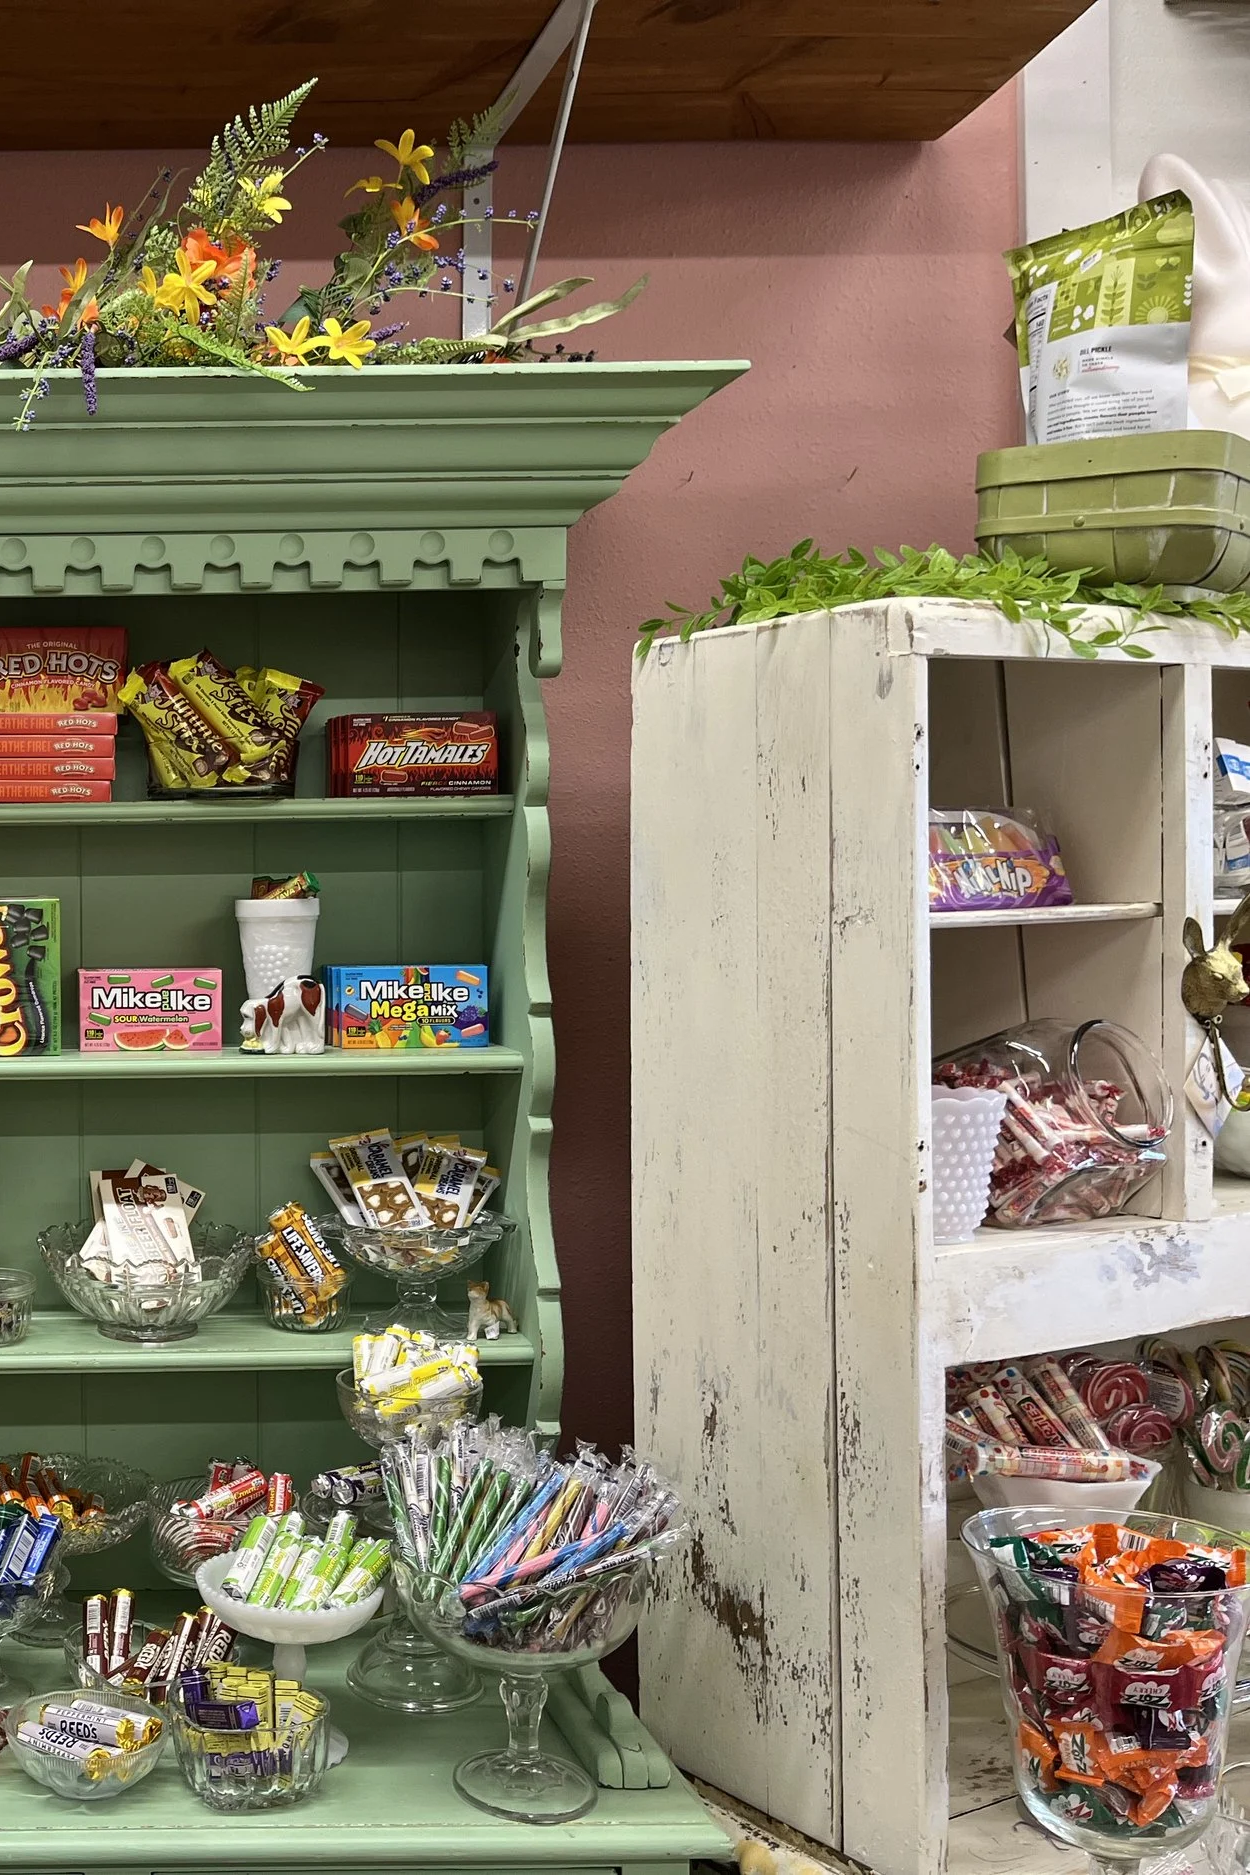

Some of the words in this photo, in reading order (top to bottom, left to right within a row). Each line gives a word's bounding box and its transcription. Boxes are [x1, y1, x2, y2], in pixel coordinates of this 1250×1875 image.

[27, 642, 40, 650] THE
[42, 641, 77, 649] ORIGINAL
[47, 651, 119, 683] HOTS
[11, 680, 42, 689] CINNAMON
[76, 679, 95, 688] CANDY
[30, 717, 54, 728] FIRE!
[57, 718, 74, 727] RED
[76, 718, 98, 727] HOTS
[27, 740, 50, 752] FIRE!
[54, 742, 70, 750] RED
[72, 742, 94, 750] HOTS
[356, 741, 401, 769] HOT
[399, 741, 491, 768] TAMALES
[27, 763, 51, 775] FIRE!
[54, 764, 70, 773] RED
[72, 764, 94, 773] HOTS
[25, 785, 48, 797] FIRE!
[51, 787, 67, 795] RED
[70, 787, 92, 796] HOTS
[92, 987, 162, 1009] Mike
[161, 990, 170, 1011] and
[169, 990, 212, 1012] Ike
[359, 981, 423, 1000] Mike
[430, 982, 470, 1002] Ike
[114, 1015, 138, 1024] SOUR
[139, 1015, 189, 1024] Watermelon
[370, 1001, 429, 1022] Mega
[368, 1142, 394, 1179] CARAMEL
[447, 1162, 468, 1196] CARAMEL
[116, 1187, 144, 1226] FLOAT
[56, 1708, 108, 1723] PEPPERMINT
[38, 1728, 79, 1749] REED'S
[59, 1719, 98, 1740] REED'S
